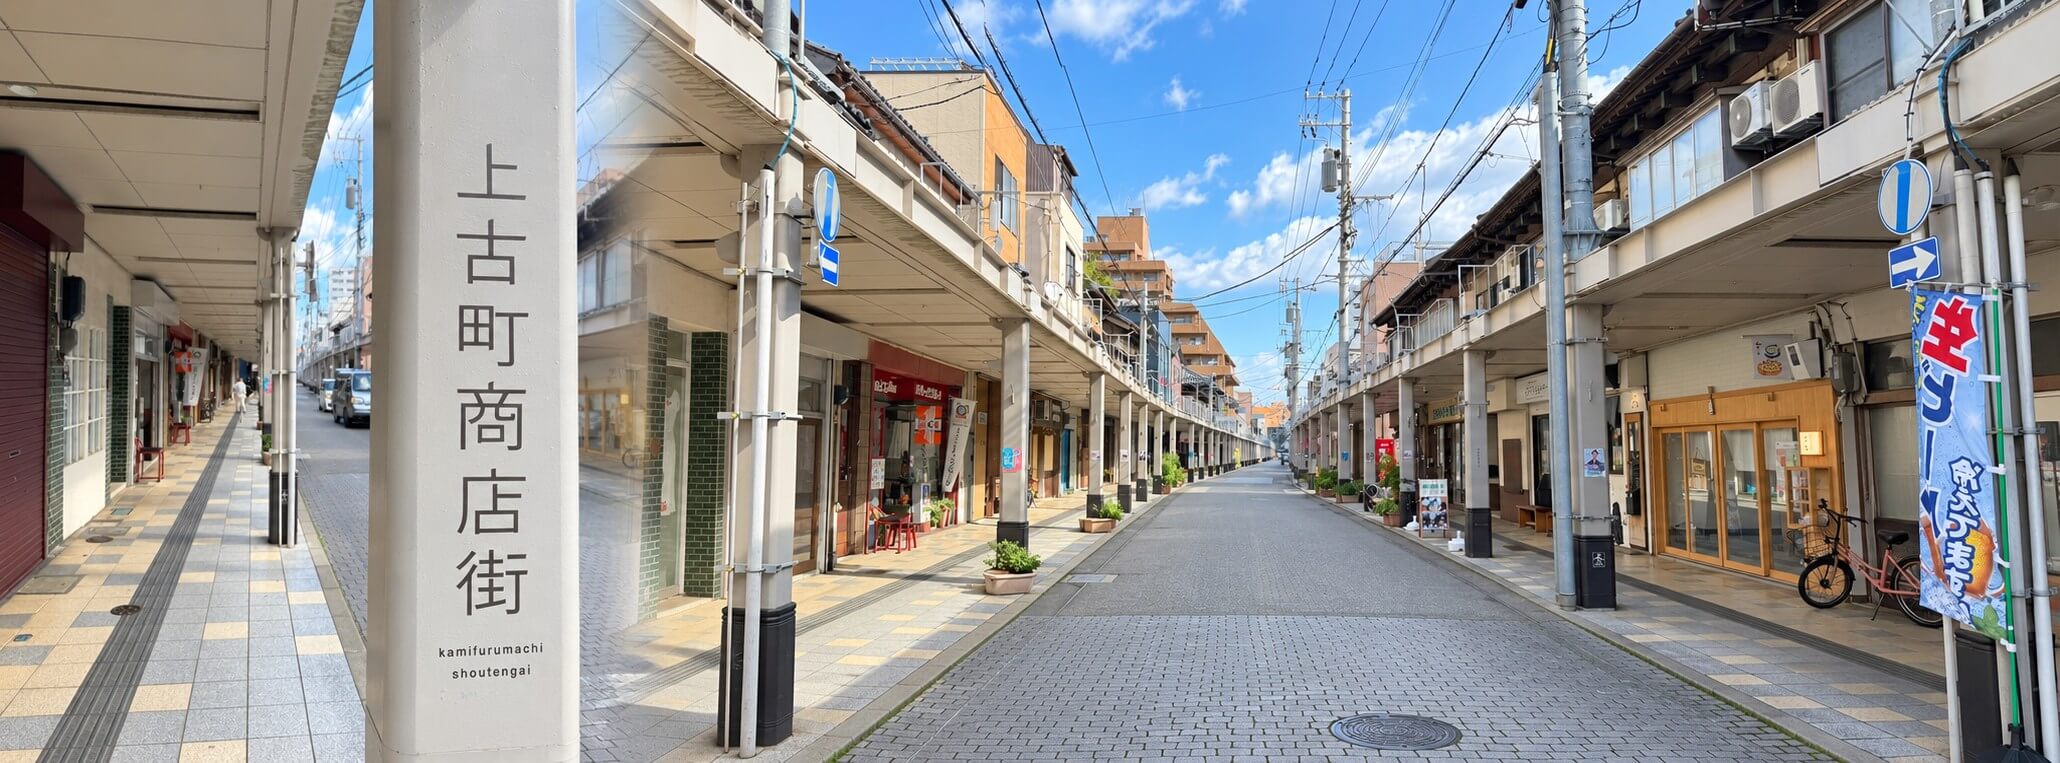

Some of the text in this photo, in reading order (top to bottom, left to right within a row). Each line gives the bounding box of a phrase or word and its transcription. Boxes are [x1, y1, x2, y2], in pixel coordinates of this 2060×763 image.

[456, 142, 529, 617] 上古町商店街
[438, 642, 543, 658] kamifurumachi
[452, 664, 531, 679] shoutengai
